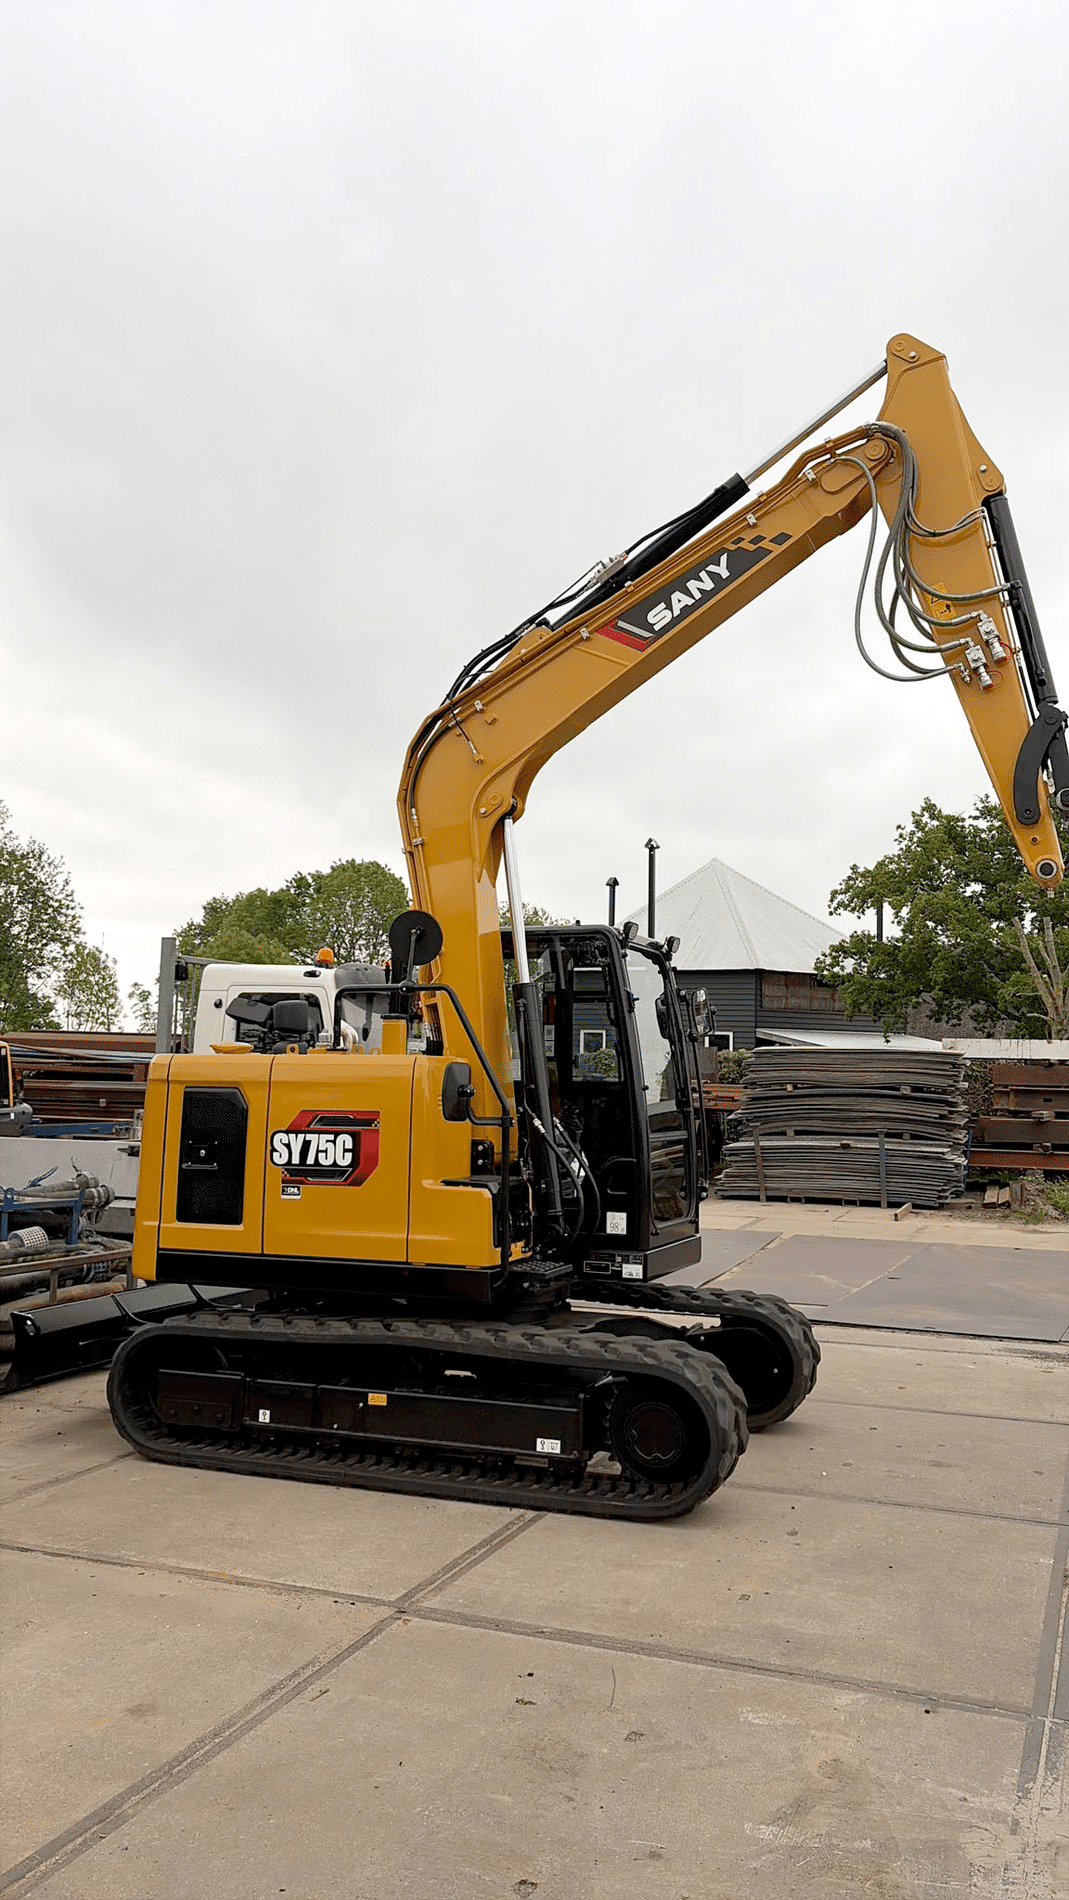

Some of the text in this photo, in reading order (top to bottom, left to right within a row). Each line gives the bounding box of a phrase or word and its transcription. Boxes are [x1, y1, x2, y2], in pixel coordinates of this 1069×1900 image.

[646, 552, 731, 632] SANY
[272, 1132, 353, 1166] SY75C
[609, 1221, 620, 1232] 98
